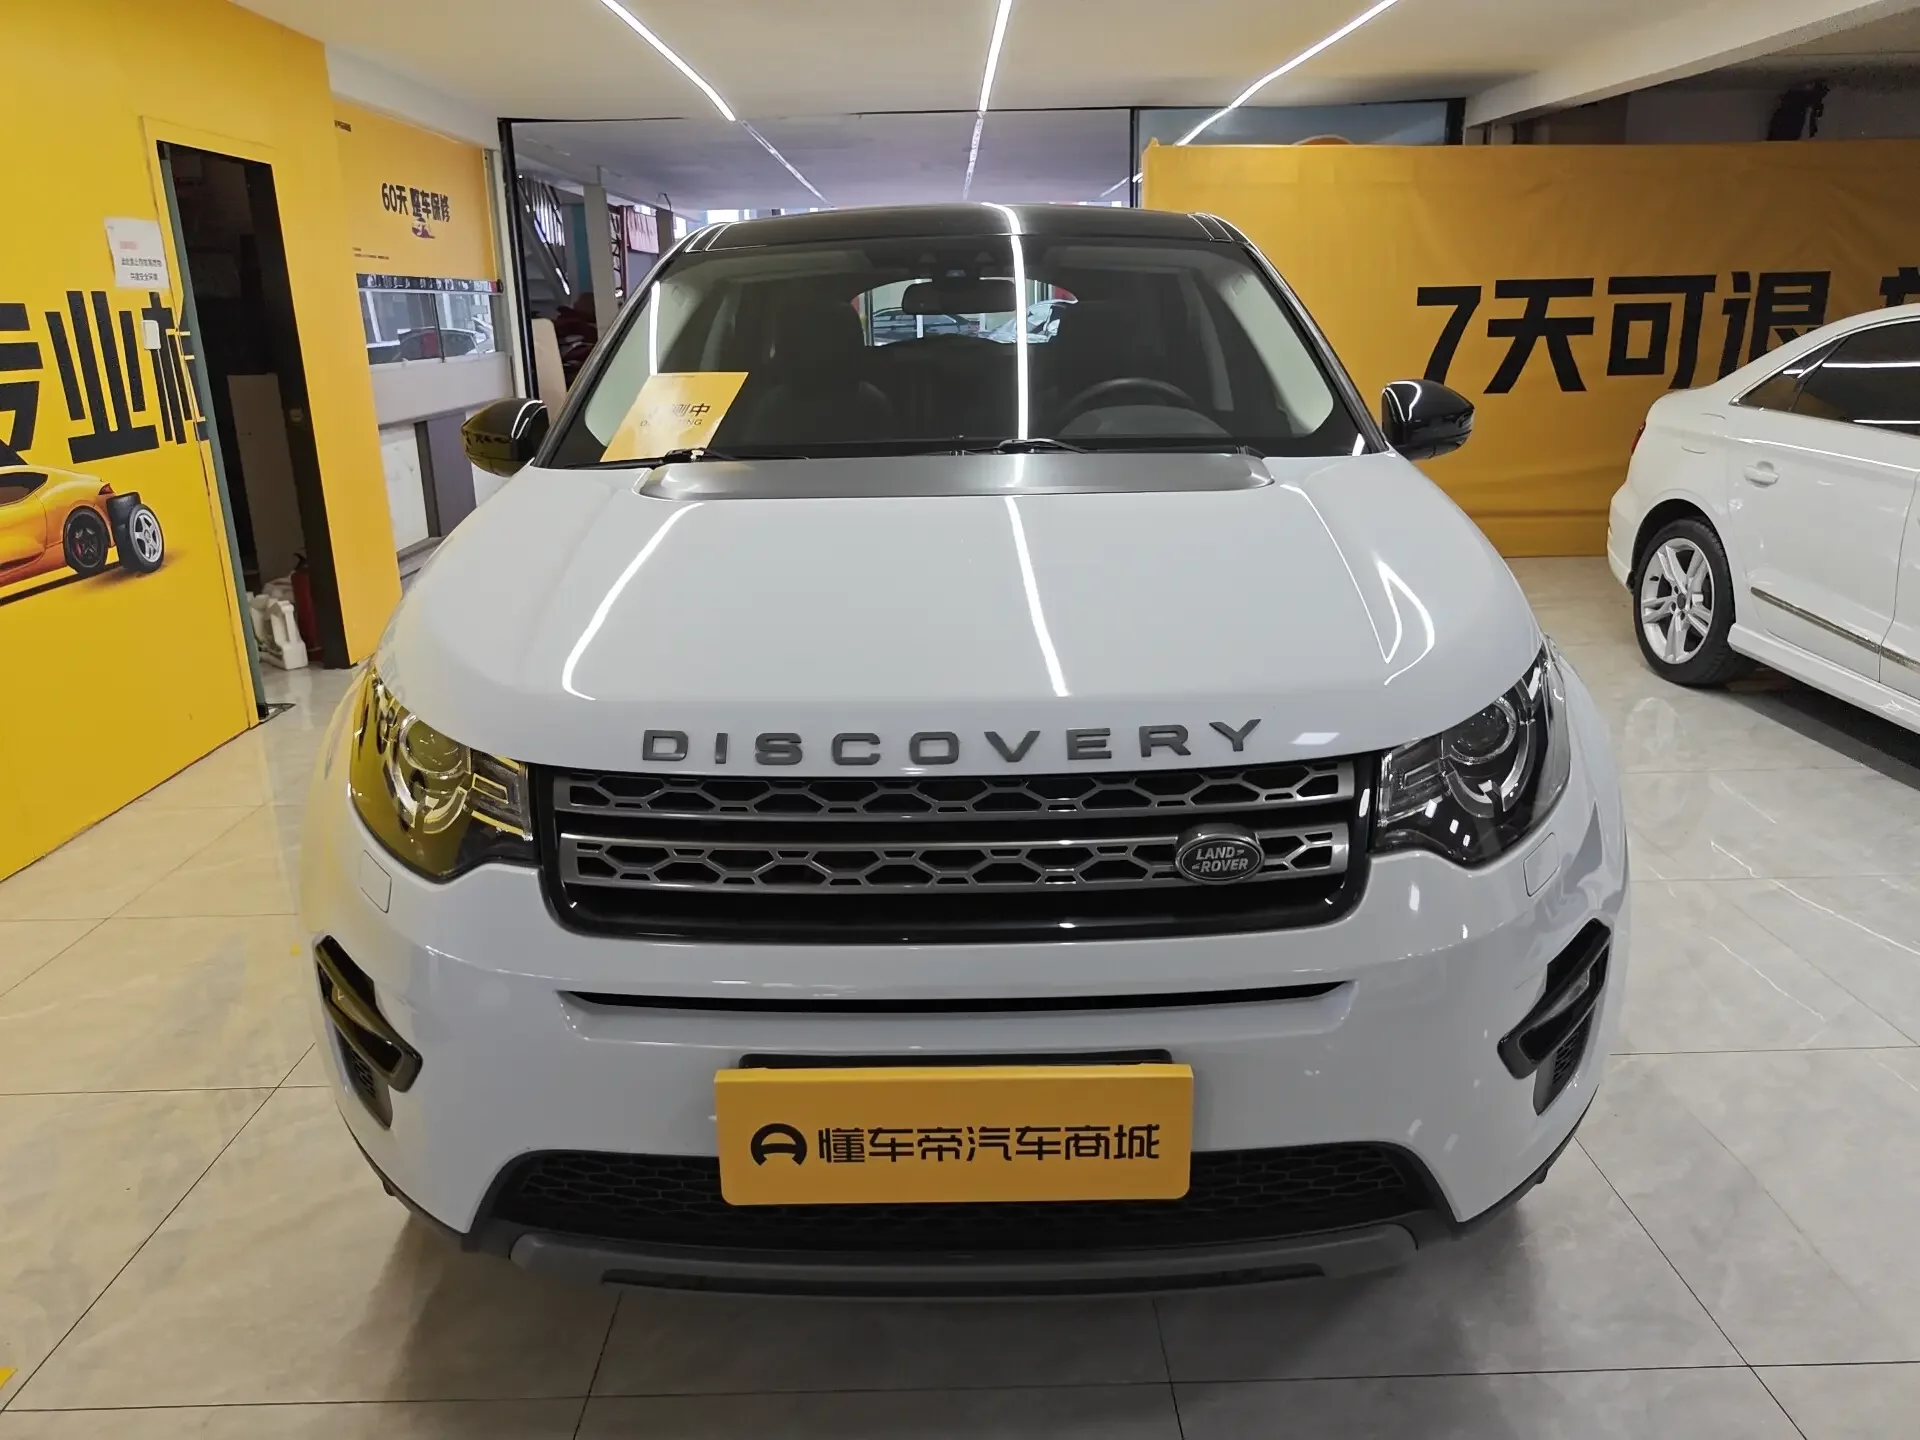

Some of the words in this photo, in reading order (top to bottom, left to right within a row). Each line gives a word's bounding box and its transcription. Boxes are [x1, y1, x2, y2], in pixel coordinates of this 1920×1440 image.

[381, 182, 409, 215] 60天
[1416, 270, 1831, 394] 7天可退
[642, 718, 1261, 765] DISCOVERY
[1195, 846, 1236, 861] LAND
[1200, 857, 1249, 873] ROVER
[817, 1123, 1161, 1164] 懂车帝汽车商城
